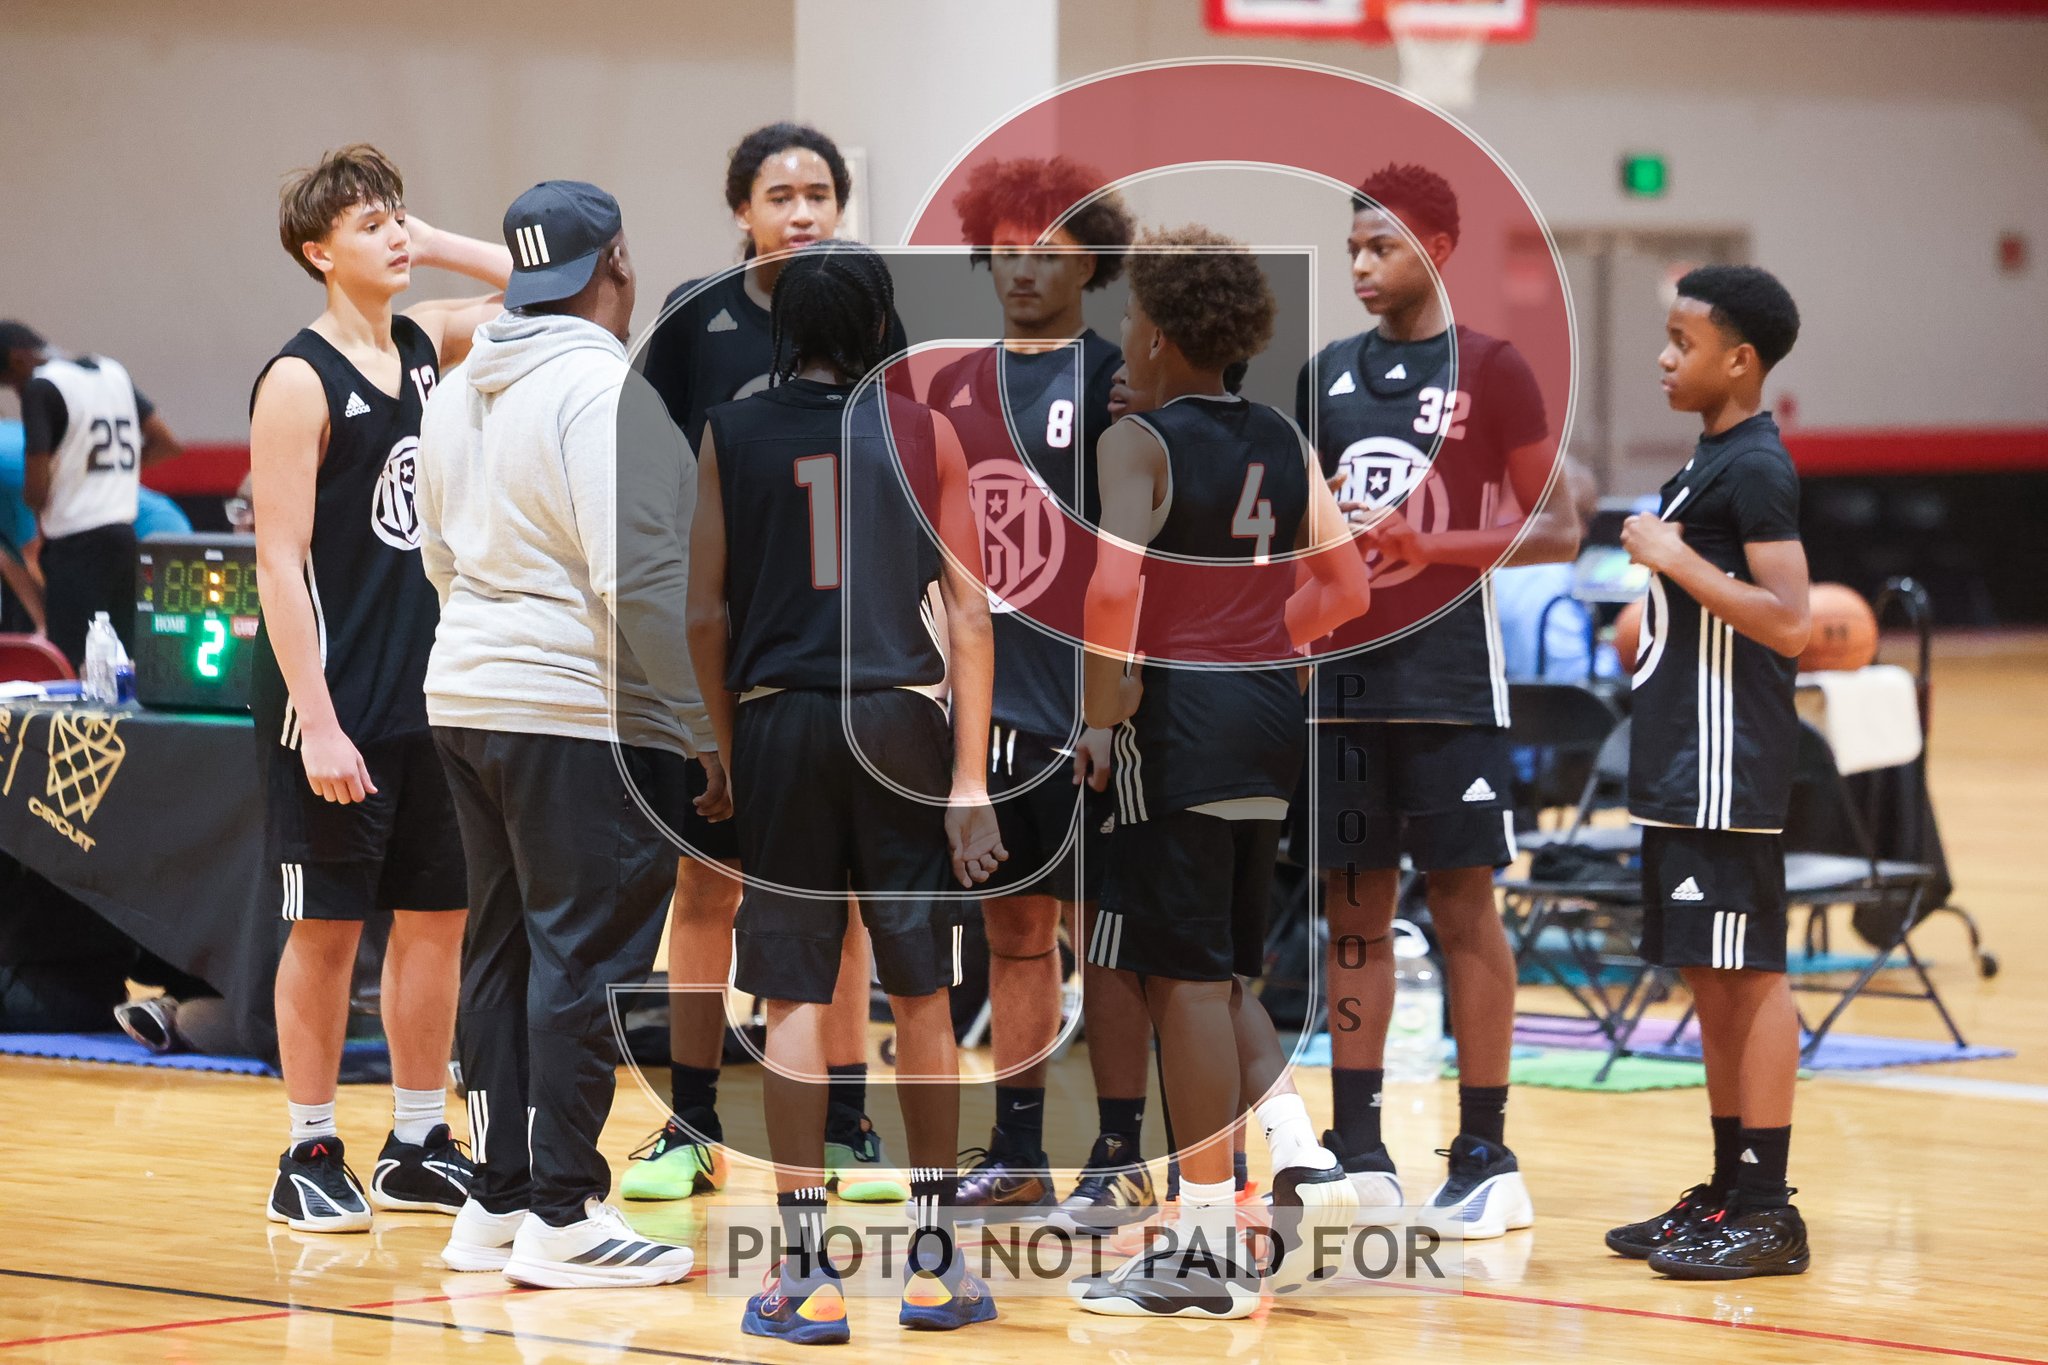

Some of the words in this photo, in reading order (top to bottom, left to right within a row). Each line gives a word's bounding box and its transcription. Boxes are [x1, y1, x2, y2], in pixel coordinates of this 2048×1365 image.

[1046, 399, 1074, 448] 8
[1413, 387, 1471, 440] 32
[87, 418, 135, 472] 25
[793, 453, 841, 590] 1
[1231, 463, 1276, 565] 4
[197, 618, 225, 677] 2
